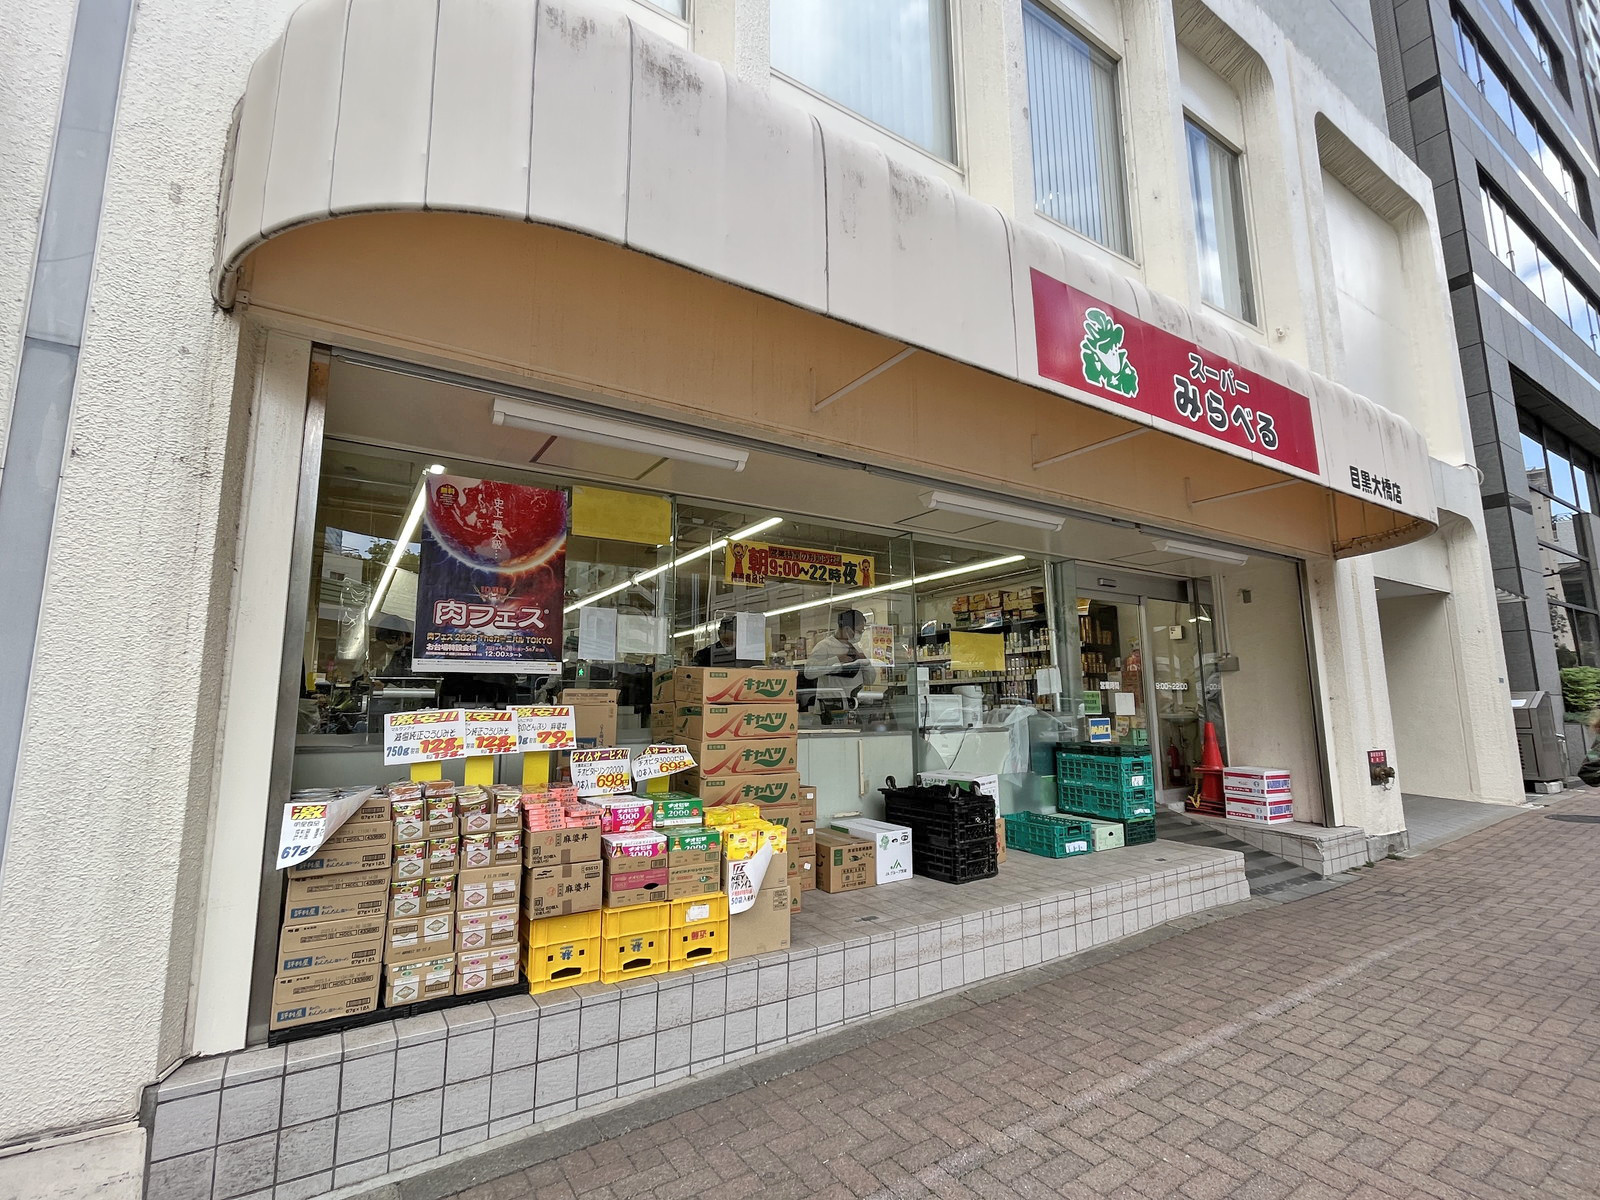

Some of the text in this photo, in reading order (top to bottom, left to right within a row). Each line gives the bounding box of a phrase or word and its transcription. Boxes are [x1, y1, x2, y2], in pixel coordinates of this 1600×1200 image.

[1188, 352, 1250, 396] スーパー
[1173, 374, 1278, 450] みらべる
[1349, 465, 1403, 505] 目黒大橋店
[434, 601, 546, 629] 肉フェス
[426, 633, 453, 642] 肉フェス
[455, 634, 478, 642] 2023
[526, 636, 553, 645] TOKYO
[744, 678, 787, 693] キャベツ
[743, 712, 787, 728] キャベツ
[386, 746, 411, 758] 750g
[572, 749, 629, 763] タイムサービス!!
[742, 748, 787, 763] キャベツ
[597, 773, 630, 788] 698円
[741, 783, 788, 799] キャベツ
[617, 812, 640, 821] 3000
[668, 809, 690, 817] 2000
[563, 833, 588, 844] 麻婆丼
[281, 845, 312, 860] 67g
[565, 882, 591, 894] 麻婆丼
